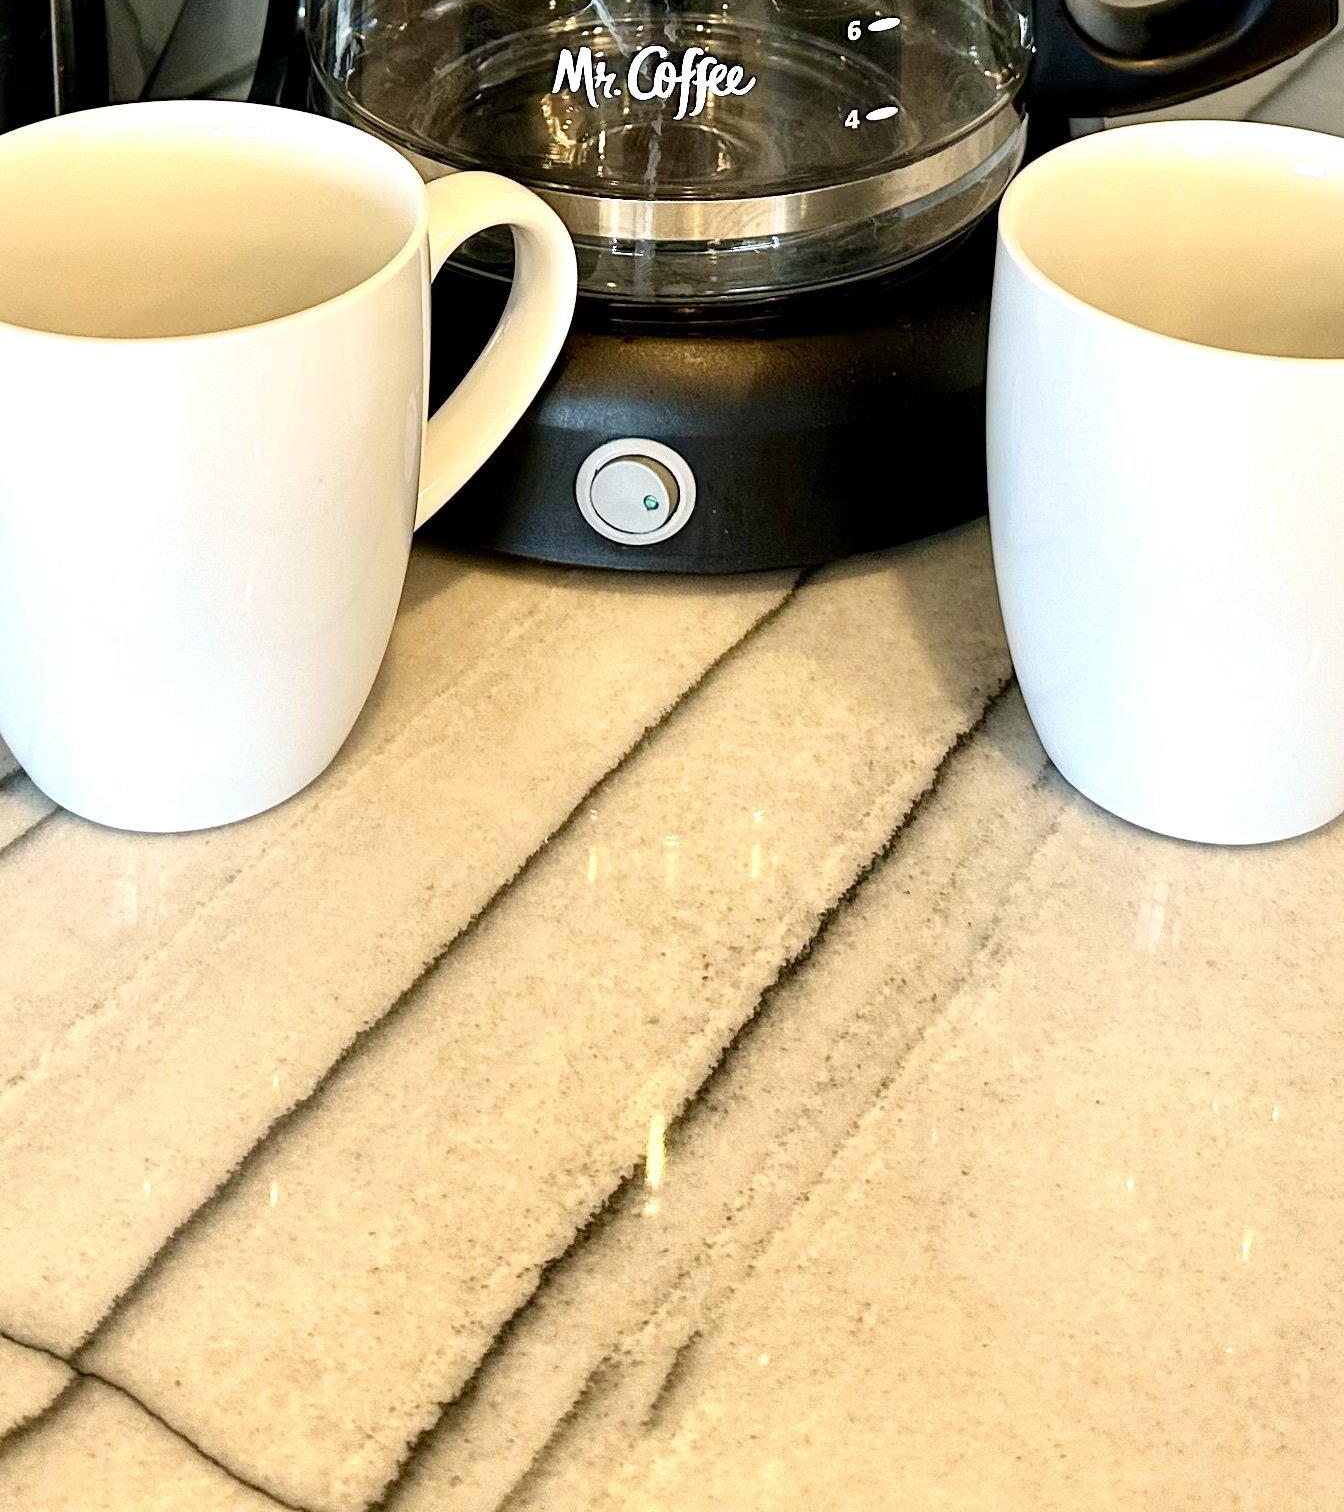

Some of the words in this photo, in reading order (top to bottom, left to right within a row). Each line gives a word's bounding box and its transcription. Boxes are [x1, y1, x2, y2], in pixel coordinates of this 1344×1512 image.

[847, 20, 862, 41] 6
[552, 46, 622, 109] Mr.
[627, 45, 757, 121] Coffee
[844, 109, 861, 129] 4
